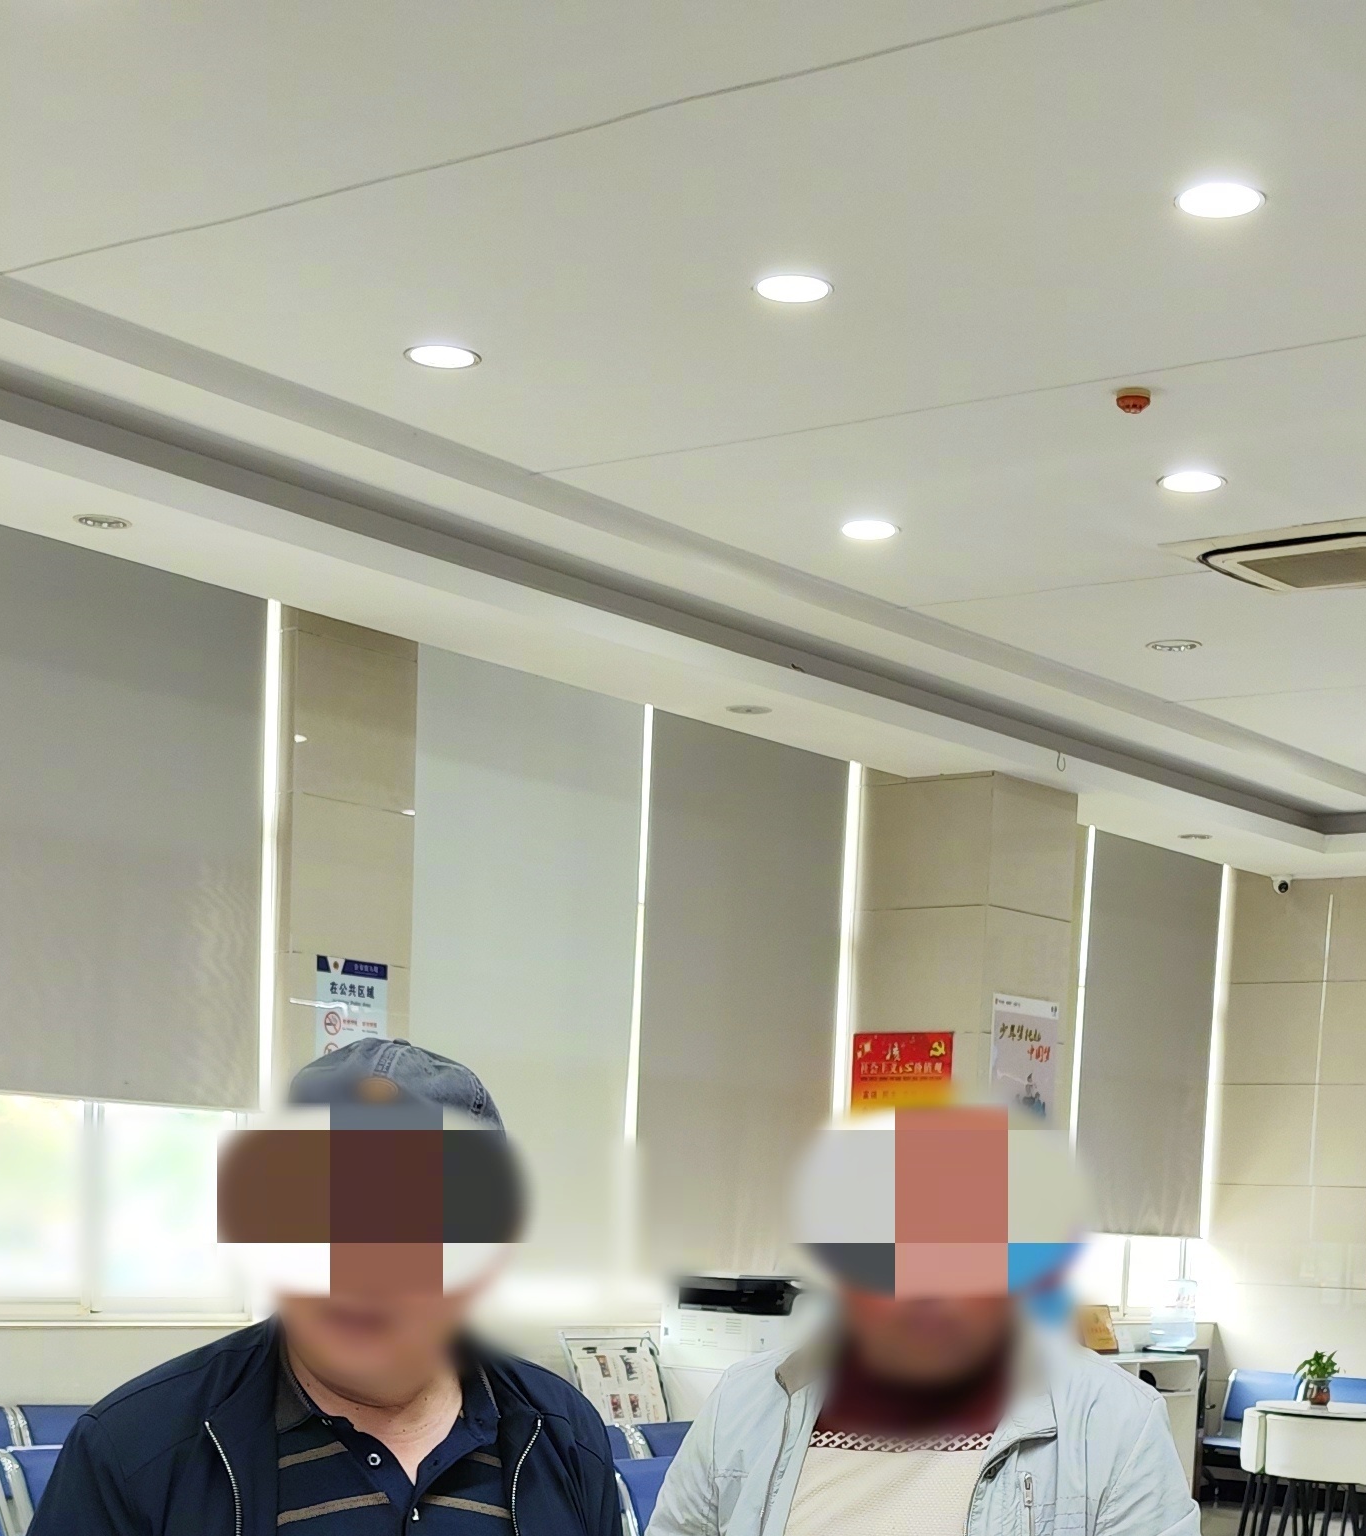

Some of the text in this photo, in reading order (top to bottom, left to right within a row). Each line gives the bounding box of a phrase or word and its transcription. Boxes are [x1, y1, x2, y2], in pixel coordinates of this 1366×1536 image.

[330, 982, 375, 999] 在公共区域
